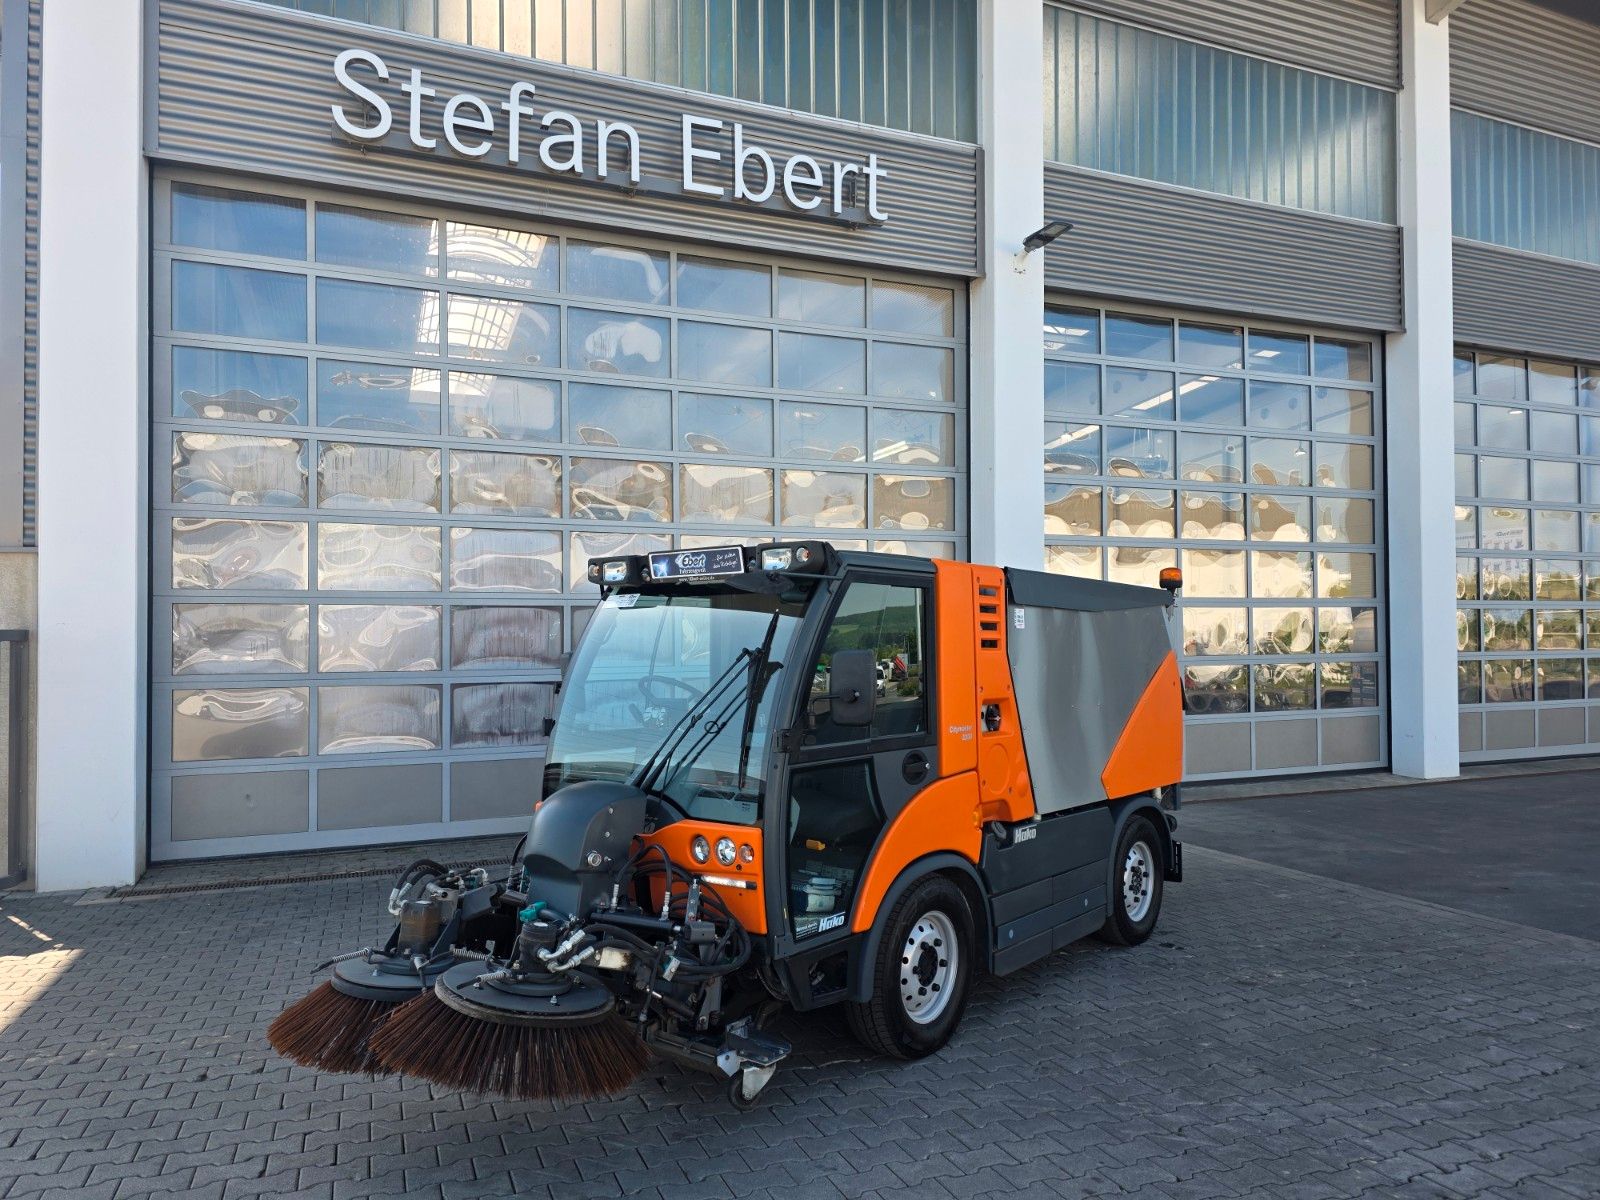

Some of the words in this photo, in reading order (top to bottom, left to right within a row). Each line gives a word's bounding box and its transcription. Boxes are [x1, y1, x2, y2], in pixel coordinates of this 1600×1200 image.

[331, 48, 641, 183] Stefan
[682, 114, 889, 221] Ebert
[1014, 826, 1037, 844] Hako
[818, 912, 845, 932] Hako
